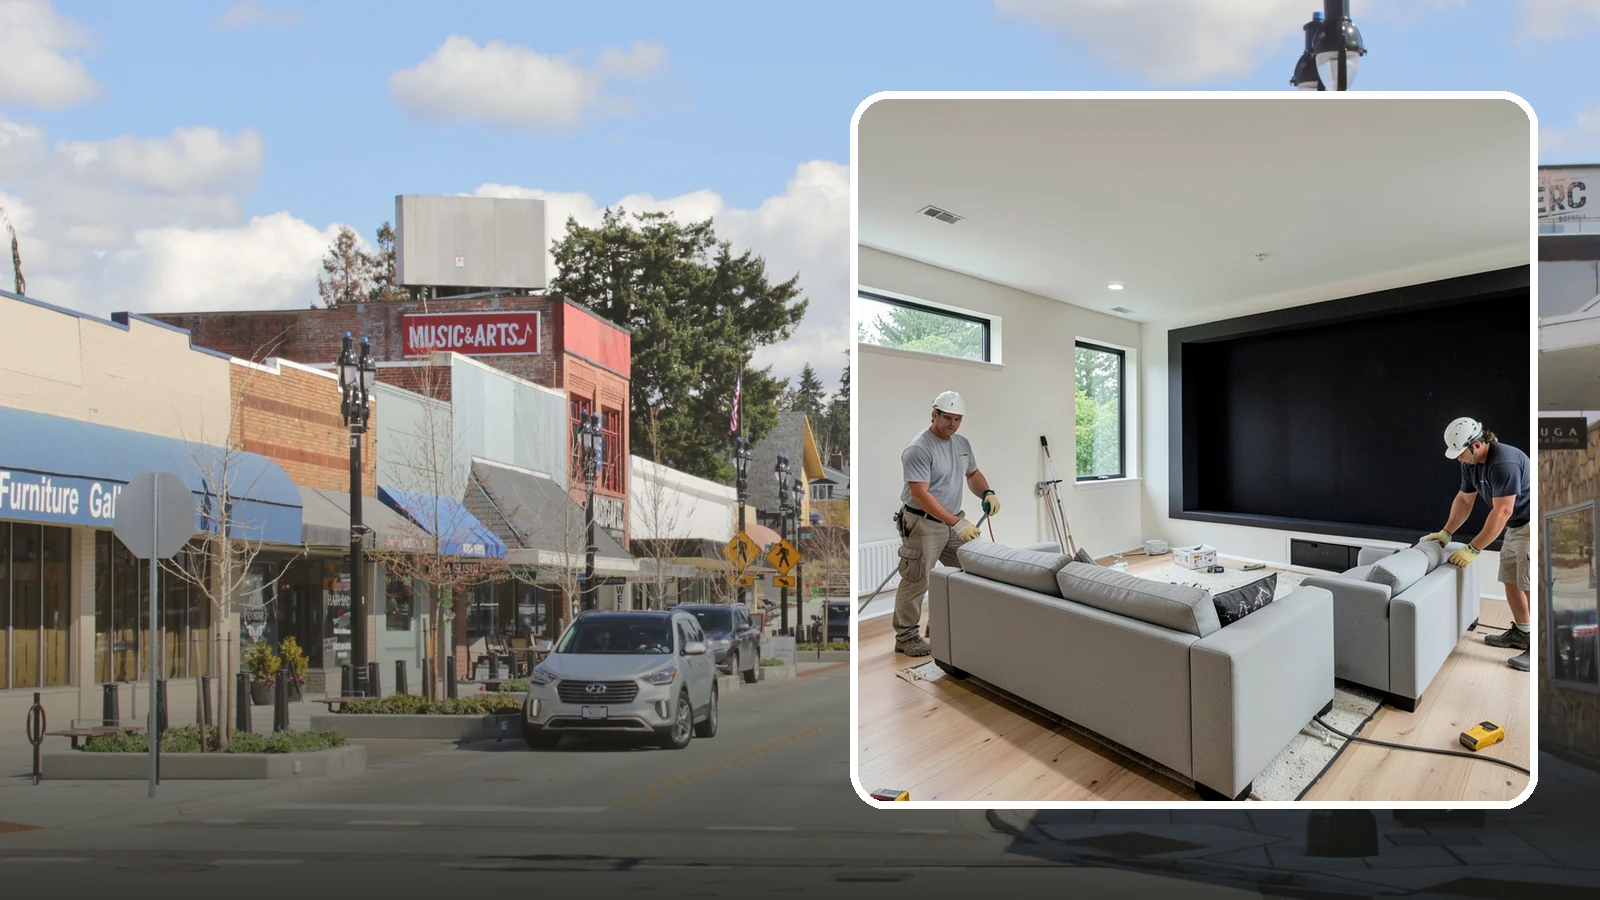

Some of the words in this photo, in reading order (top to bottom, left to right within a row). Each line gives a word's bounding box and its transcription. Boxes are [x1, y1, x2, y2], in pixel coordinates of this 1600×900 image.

[0, 471, 79, 515] Furniture
[89, 482, 122, 519] Gal
[453, 563, 479, 574] SUSHI
